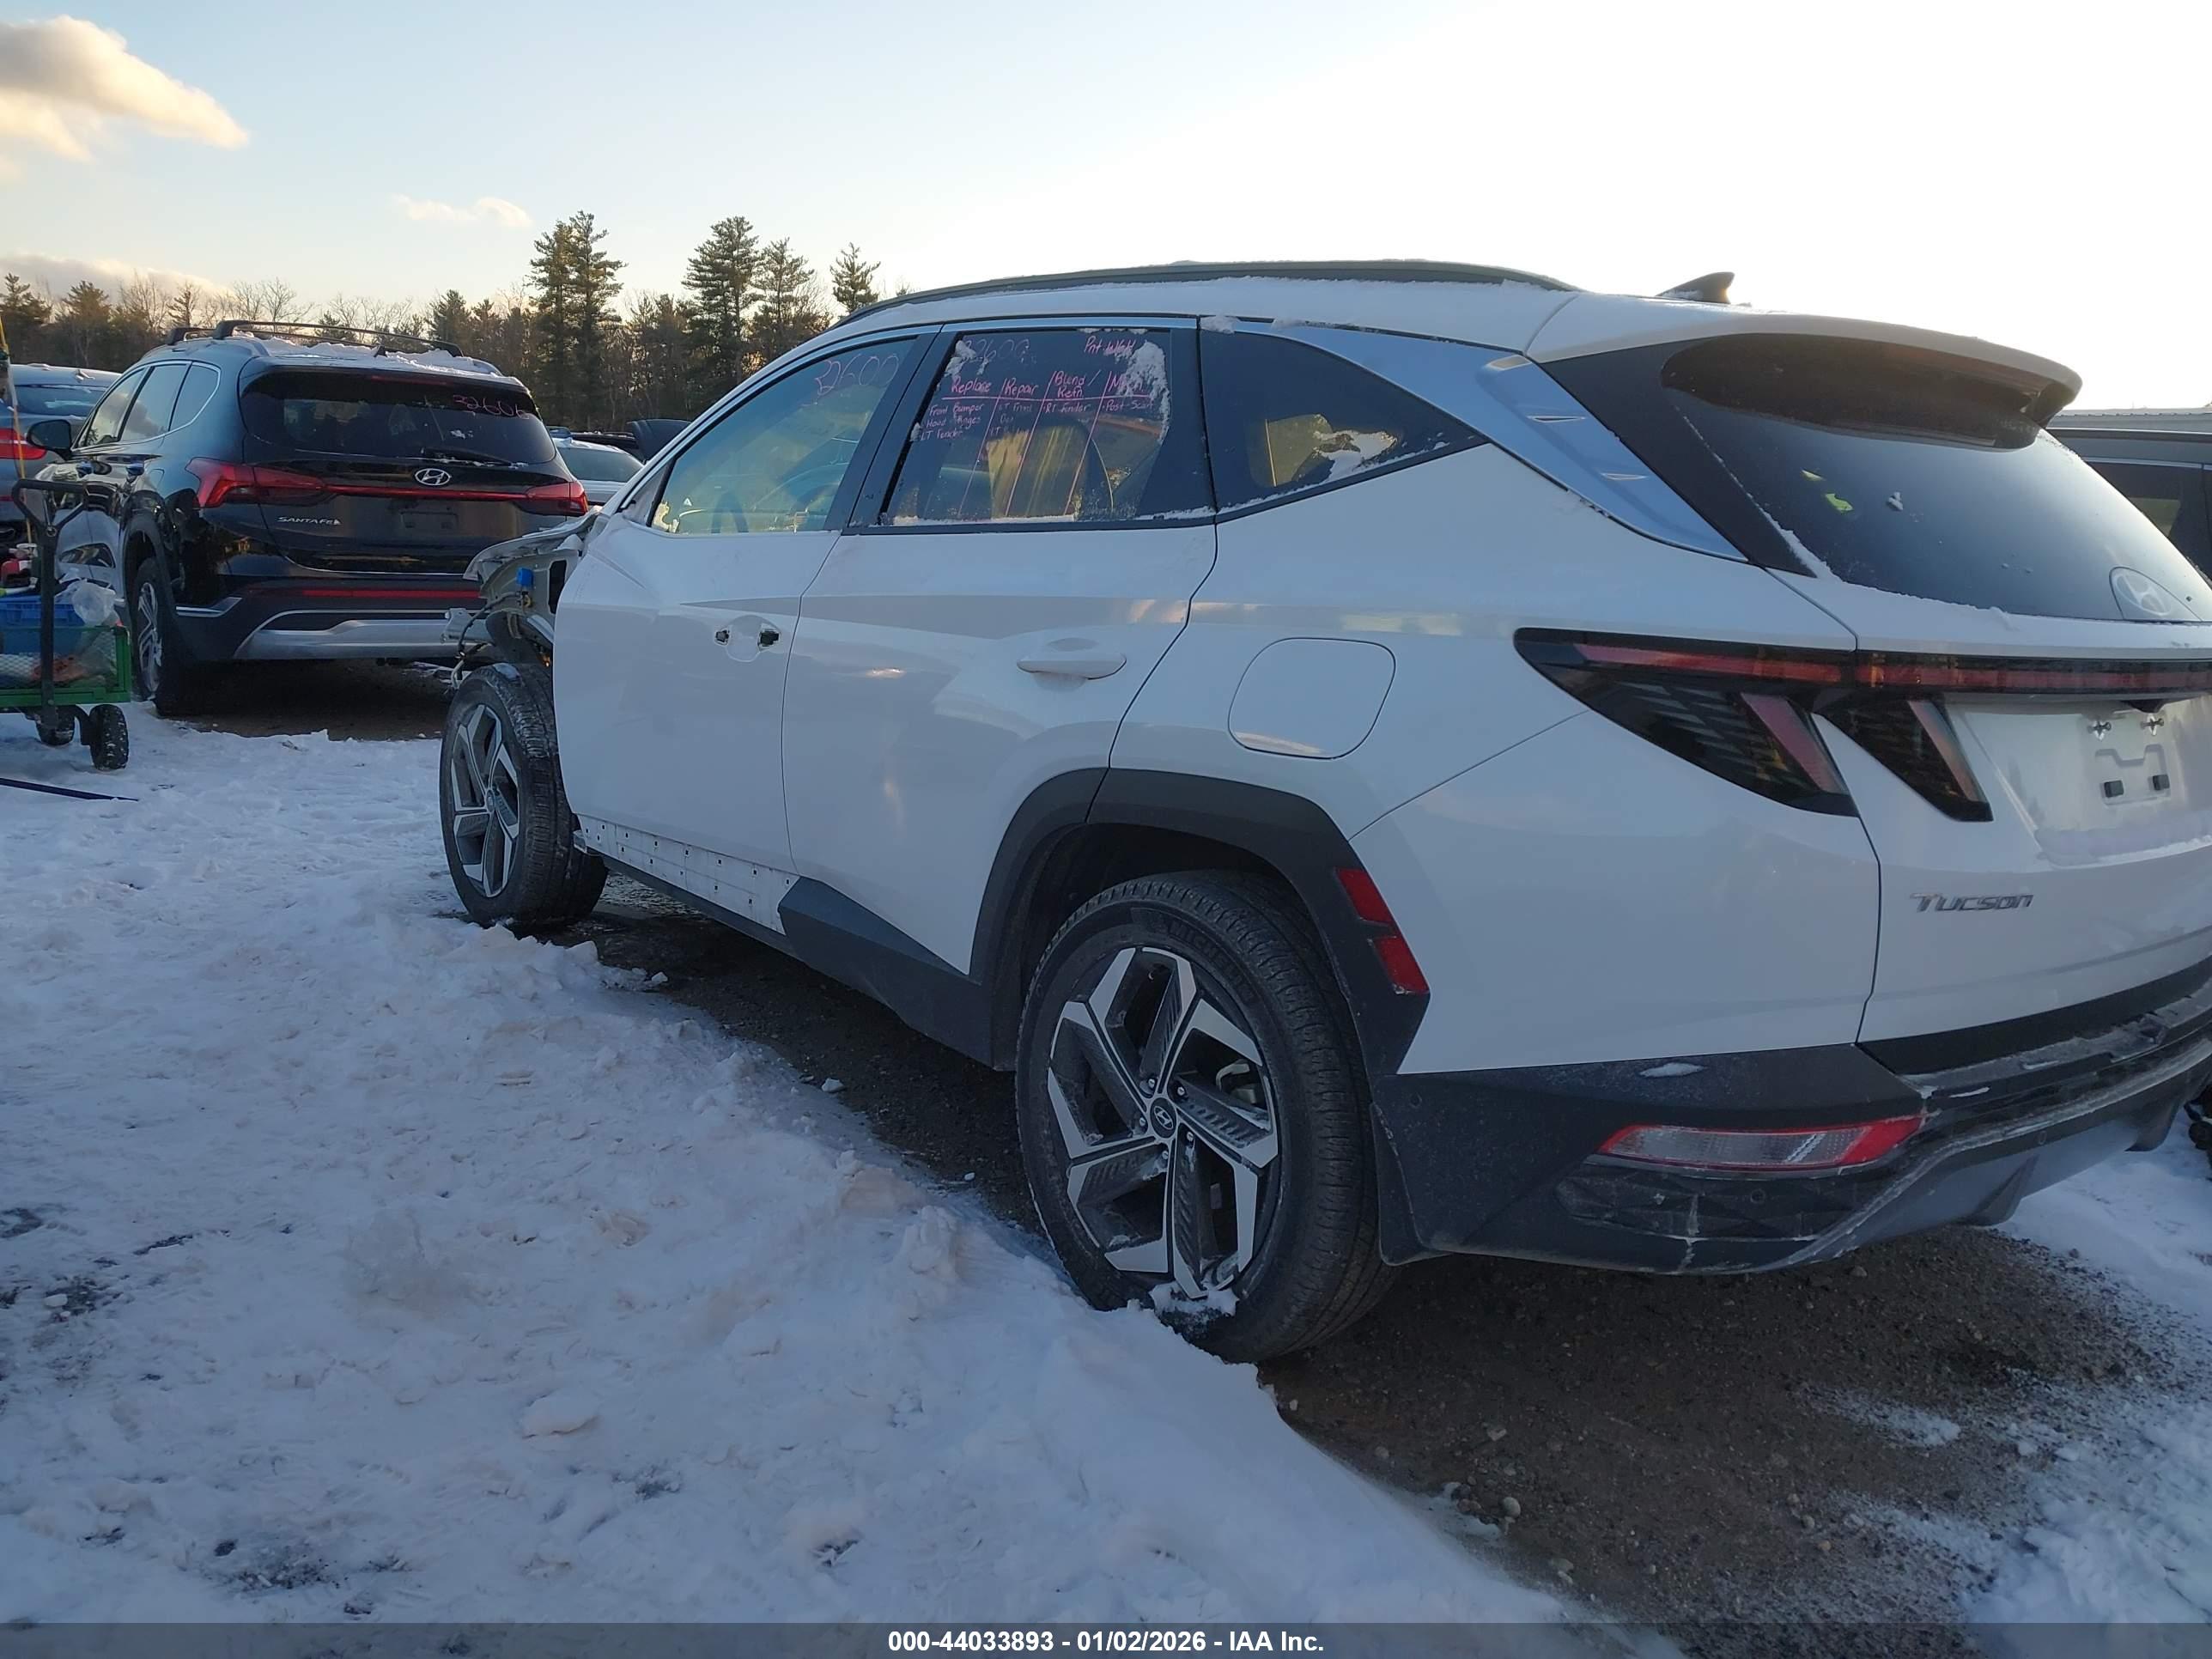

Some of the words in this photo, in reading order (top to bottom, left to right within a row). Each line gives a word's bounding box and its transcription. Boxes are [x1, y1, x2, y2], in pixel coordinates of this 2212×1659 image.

[951, 374, 992, 395] Replace
[1006, 376, 1039, 398] Repair
[1054, 370, 1086, 386] Blend
[952, 401, 985, 416] Bumper
[276, 516, 319, 525] SANTA
[1910, 892, 2034, 913] TUCSON
